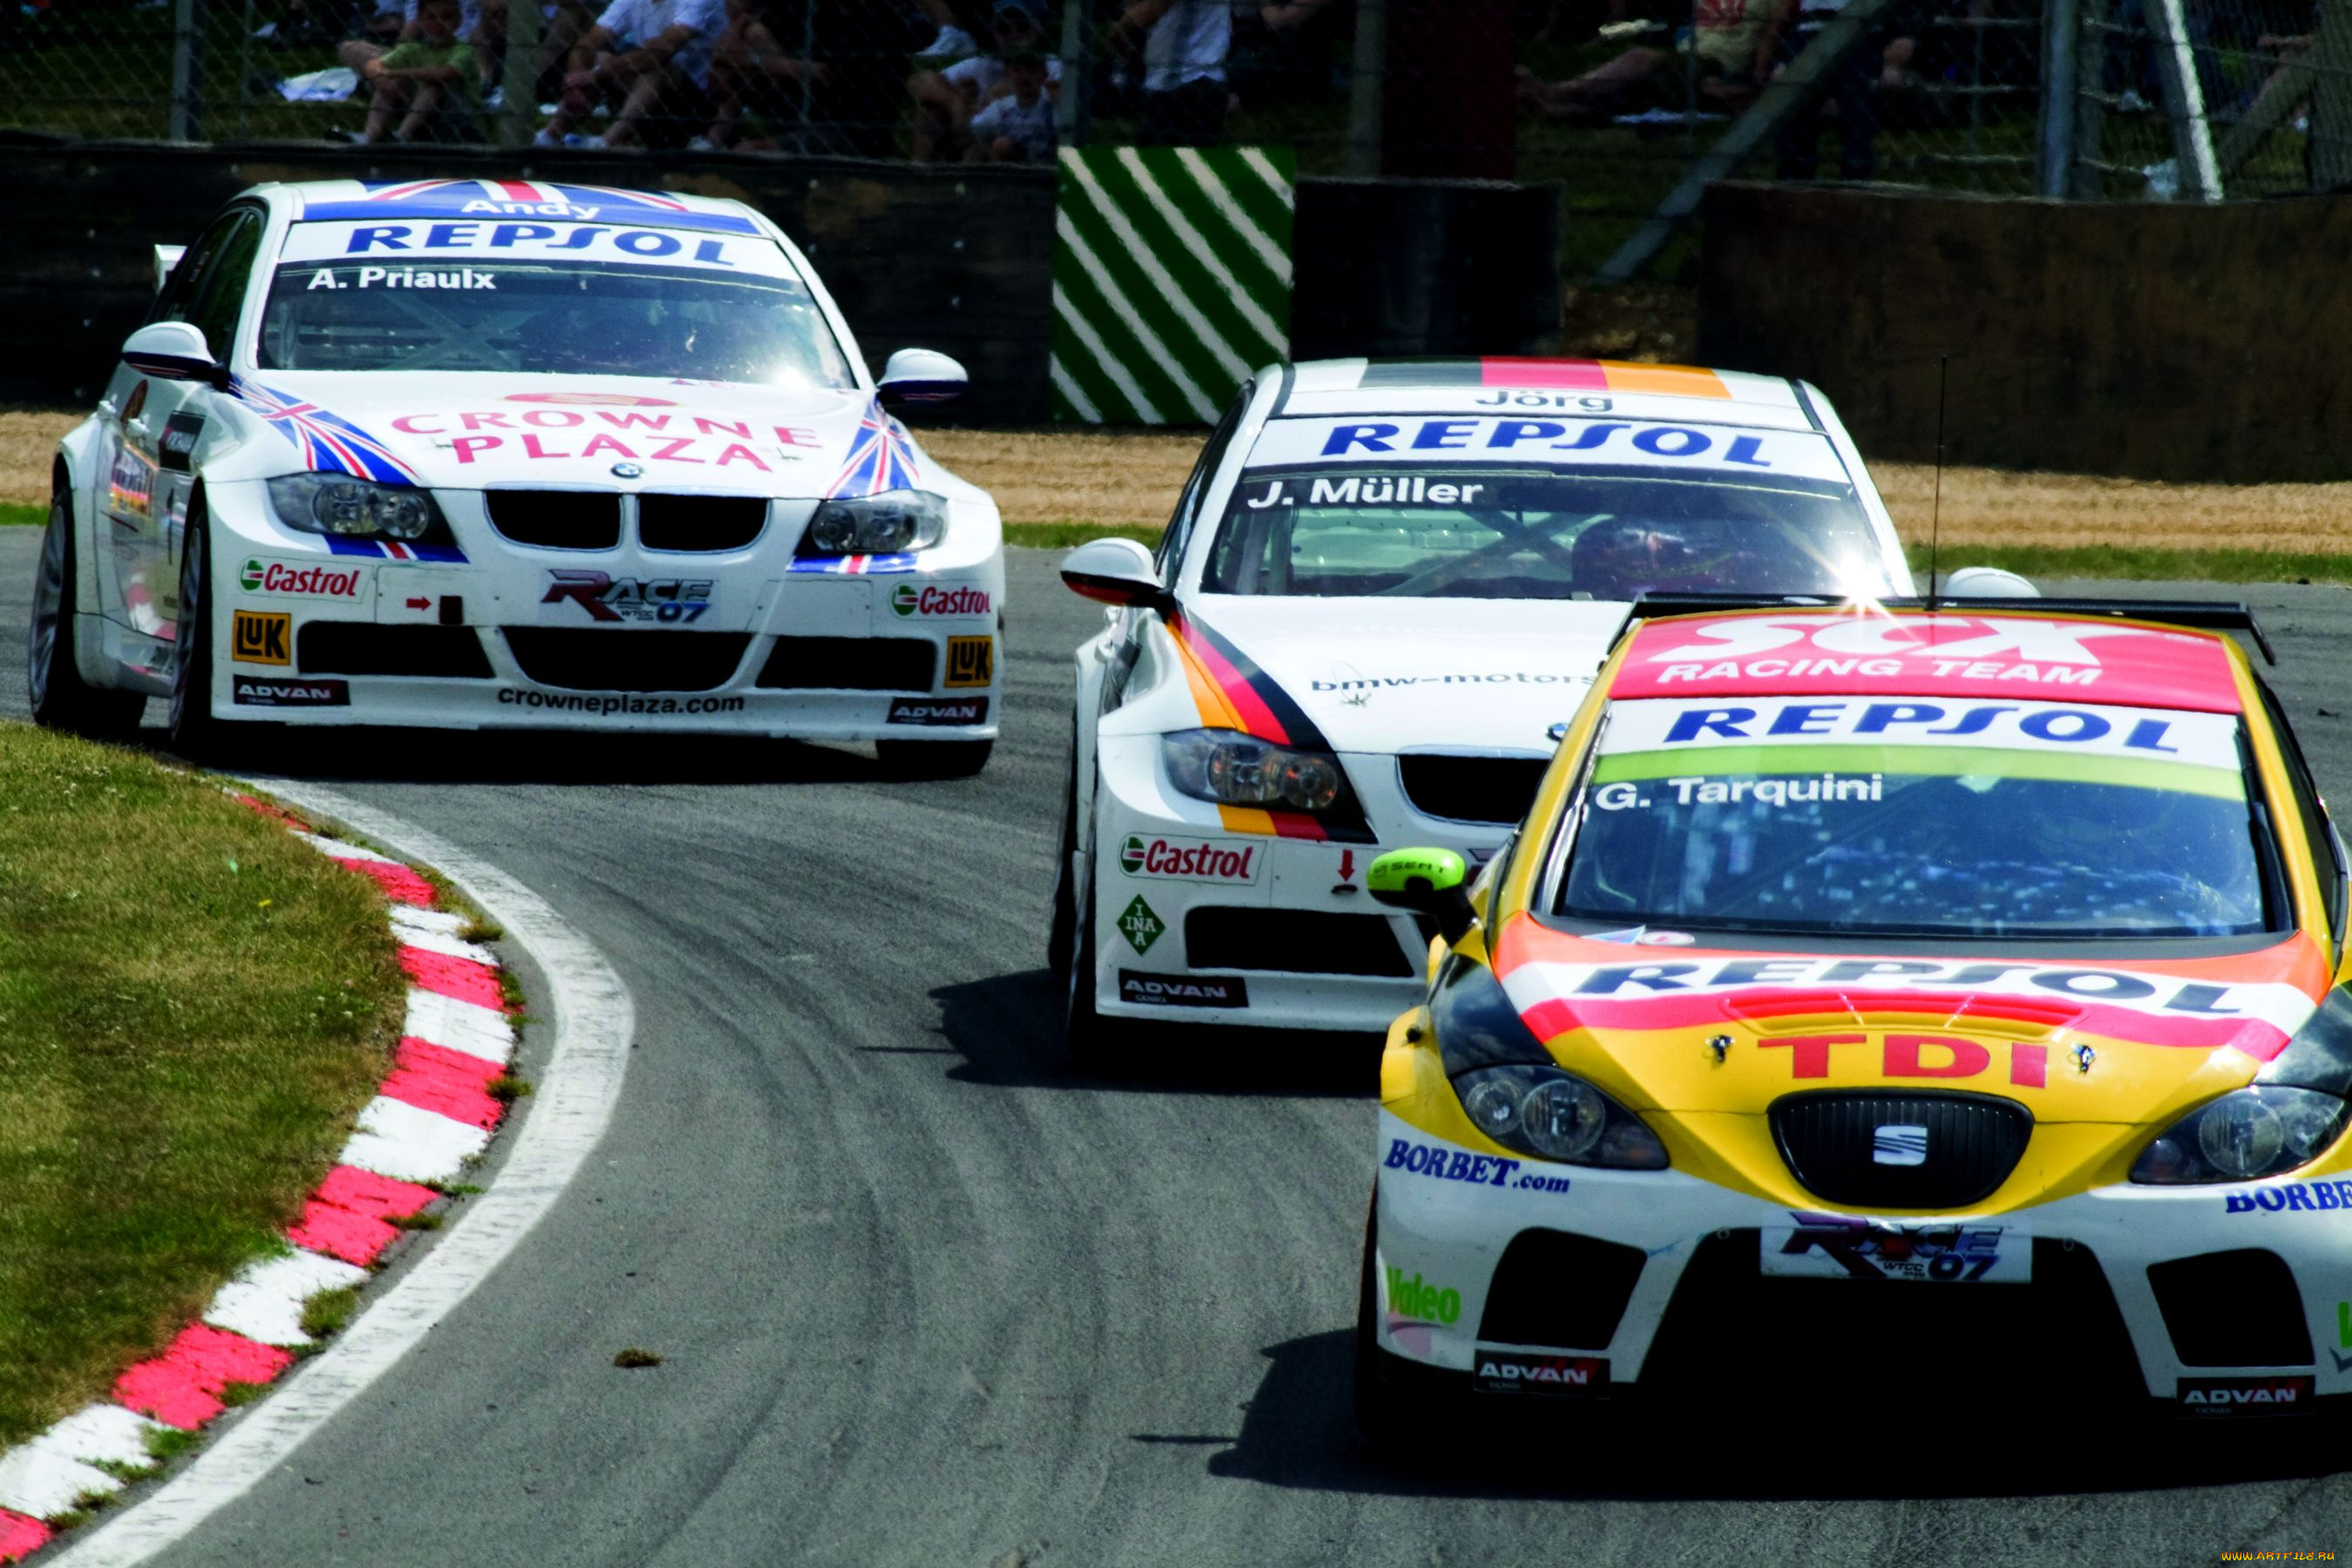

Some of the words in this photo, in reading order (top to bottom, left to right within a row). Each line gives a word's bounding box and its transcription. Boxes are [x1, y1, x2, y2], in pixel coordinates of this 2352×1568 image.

[461, 199, 600, 220] Andy
[346, 224, 735, 266] REPSOL
[307, 268, 348, 289] A.
[359, 267, 497, 290] Priaulx
[1475, 388, 1612, 413] Jörg
[391, 409, 822, 448] CROWNE
[1320, 420, 1772, 467] REPSOL
[451, 433, 774, 472] PLAZA
[1247, 481, 1294, 510] J.
[1309, 477, 1483, 505] Müller
[265, 564, 360, 597] Castrol
[540, 570, 713, 621] RACE
[656, 602, 711, 623] 07
[1647, 615, 2152, 666] SCX
[1657, 658, 1903, 683] RACING
[1930, 659, 2105, 686] TEAM
[238, 684, 331, 700] ADVAN
[497, 688, 745, 716] crowneplaza.com
[895, 706, 977, 718] ADVAN
[1663, 702, 2179, 753] REPSOL
[1595, 781, 1650, 811] G.
[1667, 773, 1882, 807] Tarquini
[1146, 839, 1253, 879] Castrol
[1125, 979, 1227, 997] ADVAN
[1576, 959, 2241, 1013] REPSOL
[1758, 1034, 2047, 1089] TDI
[1383, 1139, 1570, 1193] BORBET.com
[1883, 1262, 1924, 1273] WTCC
[1929, 1254, 2000, 1281] 07
[1479, 1362, 1587, 1384] ADVAN
[2183, 1389, 2296, 1403] ADVAN
